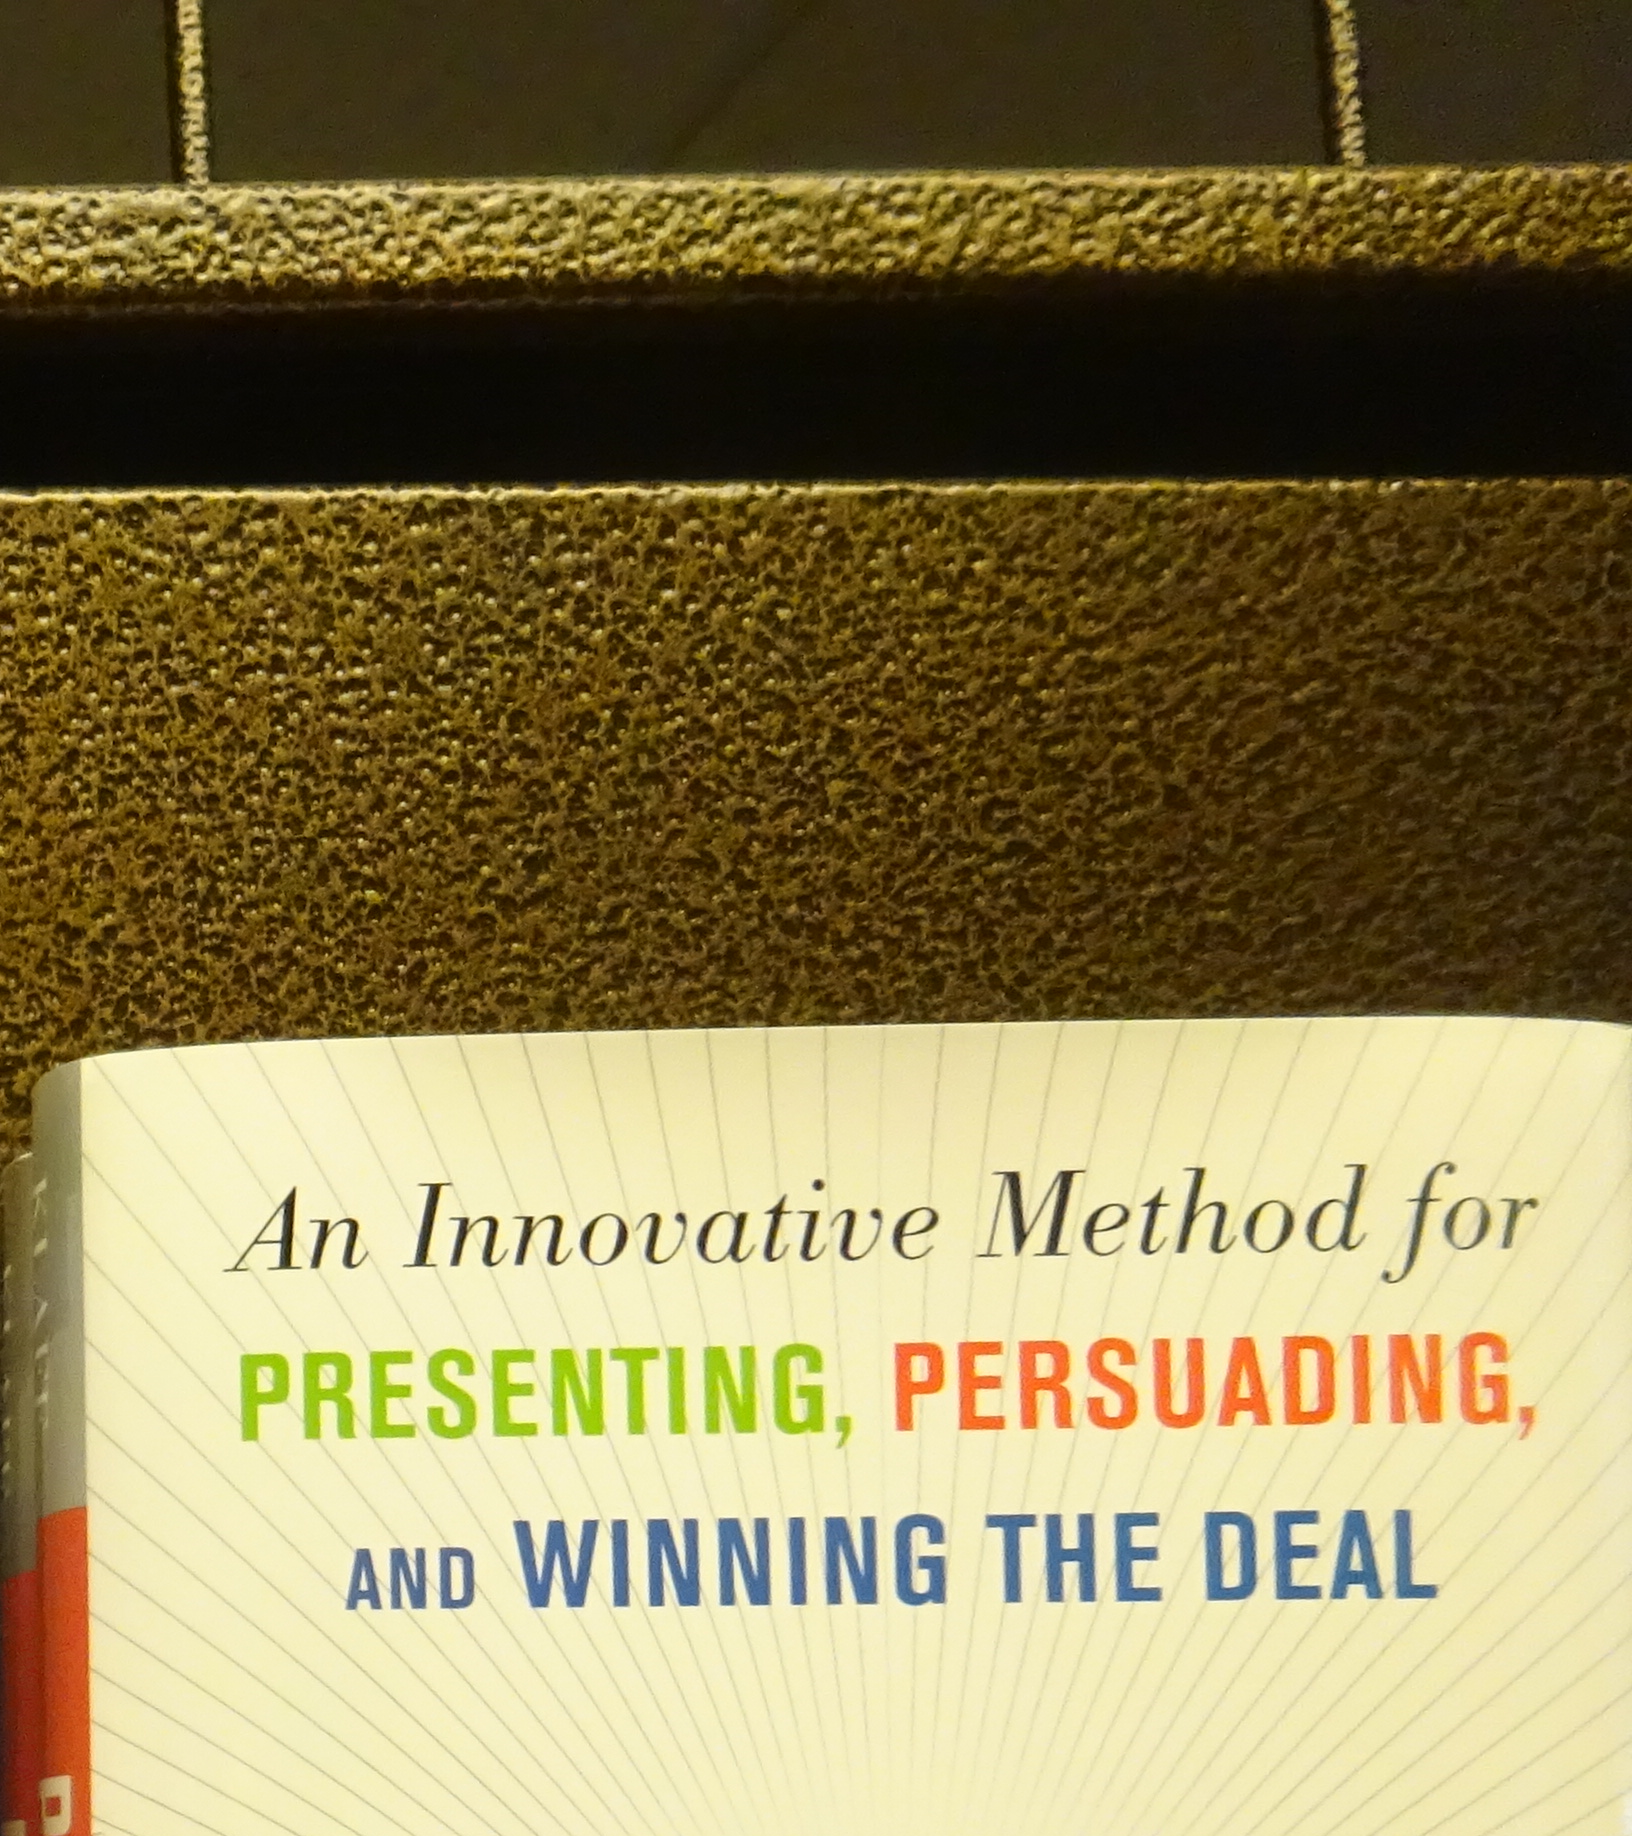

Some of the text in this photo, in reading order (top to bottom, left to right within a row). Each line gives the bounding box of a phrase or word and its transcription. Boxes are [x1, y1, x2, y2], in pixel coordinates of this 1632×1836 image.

[224, 1159, 1540, 1286] An Innovative Method for
[237, 1329, 1539, 1450] PRESENTING, PERSUADING,
[344, 1507, 1440, 1612] AND WINNING THE DEAL
